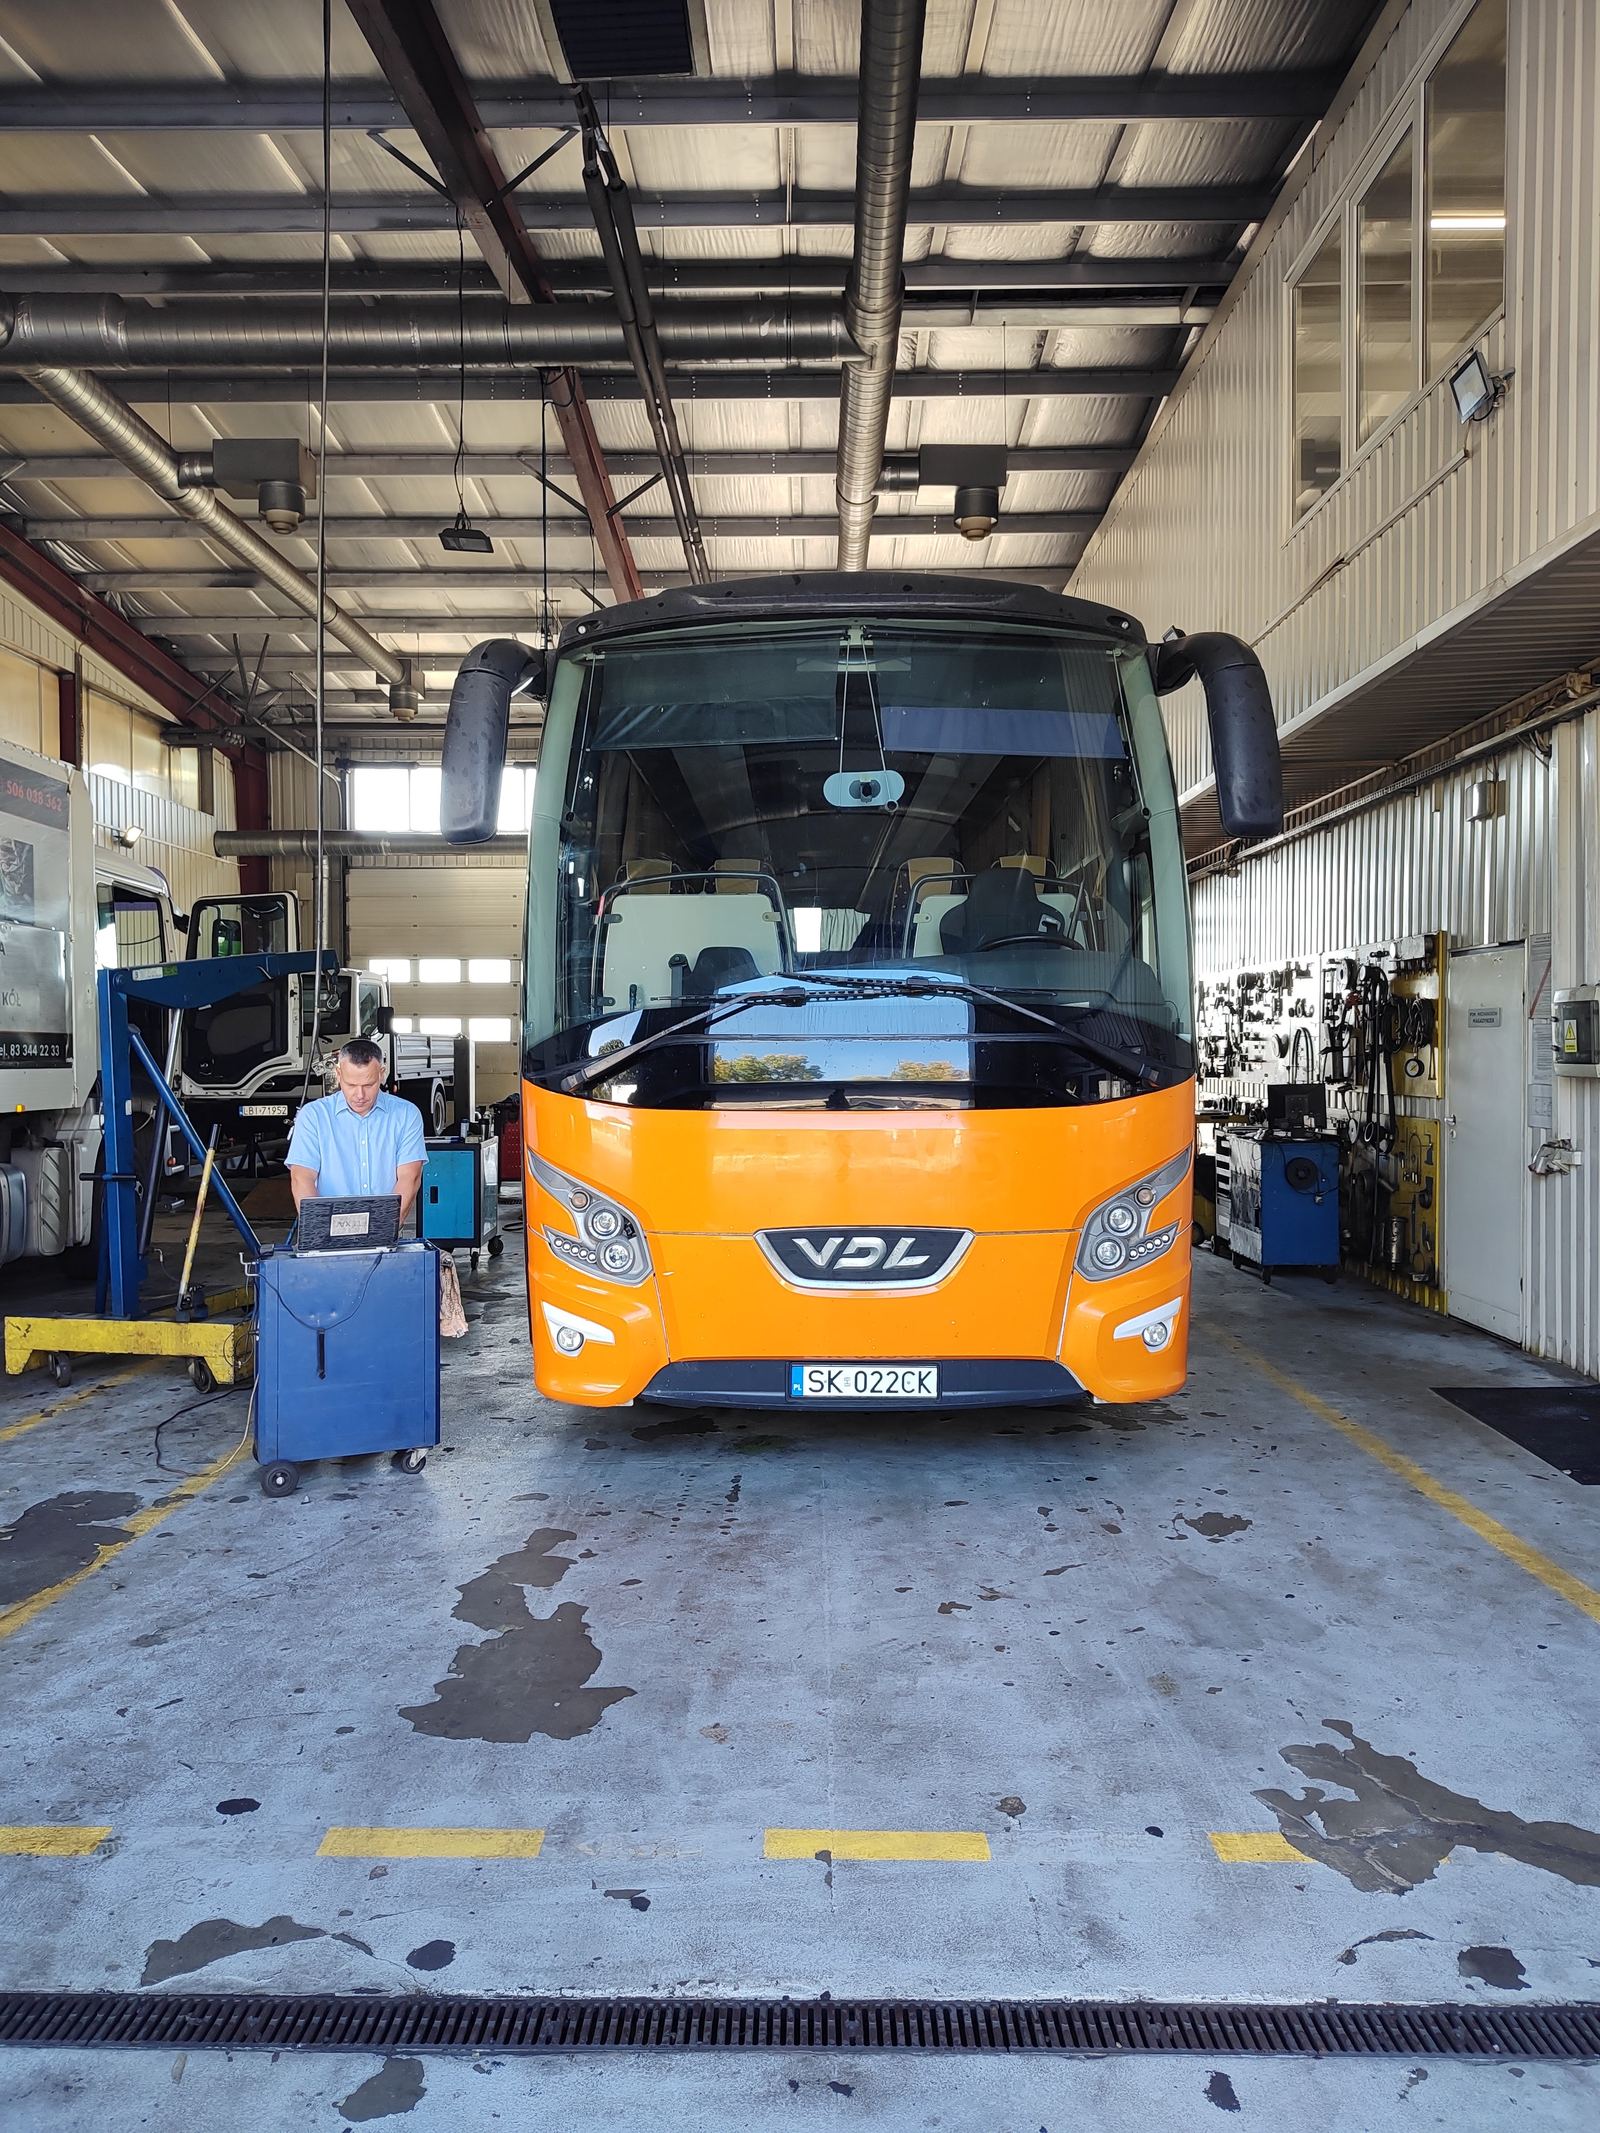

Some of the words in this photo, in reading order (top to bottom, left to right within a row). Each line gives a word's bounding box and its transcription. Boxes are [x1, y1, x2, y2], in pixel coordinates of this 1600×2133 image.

[6, 780, 24, 799] 506
[26, 787, 44, 805] 038
[10, 1044, 20, 1056] 83
[22, 1044, 38, 1056] 344
[39, 1044, 49, 1056] 22
[50, 1044, 60, 1056] 33
[791, 1237, 930, 1269] VDL
[793, 1383, 802, 1391] PL
[808, 1370, 844, 1393] SK
[854, 1370, 932, 1393] 022CK
